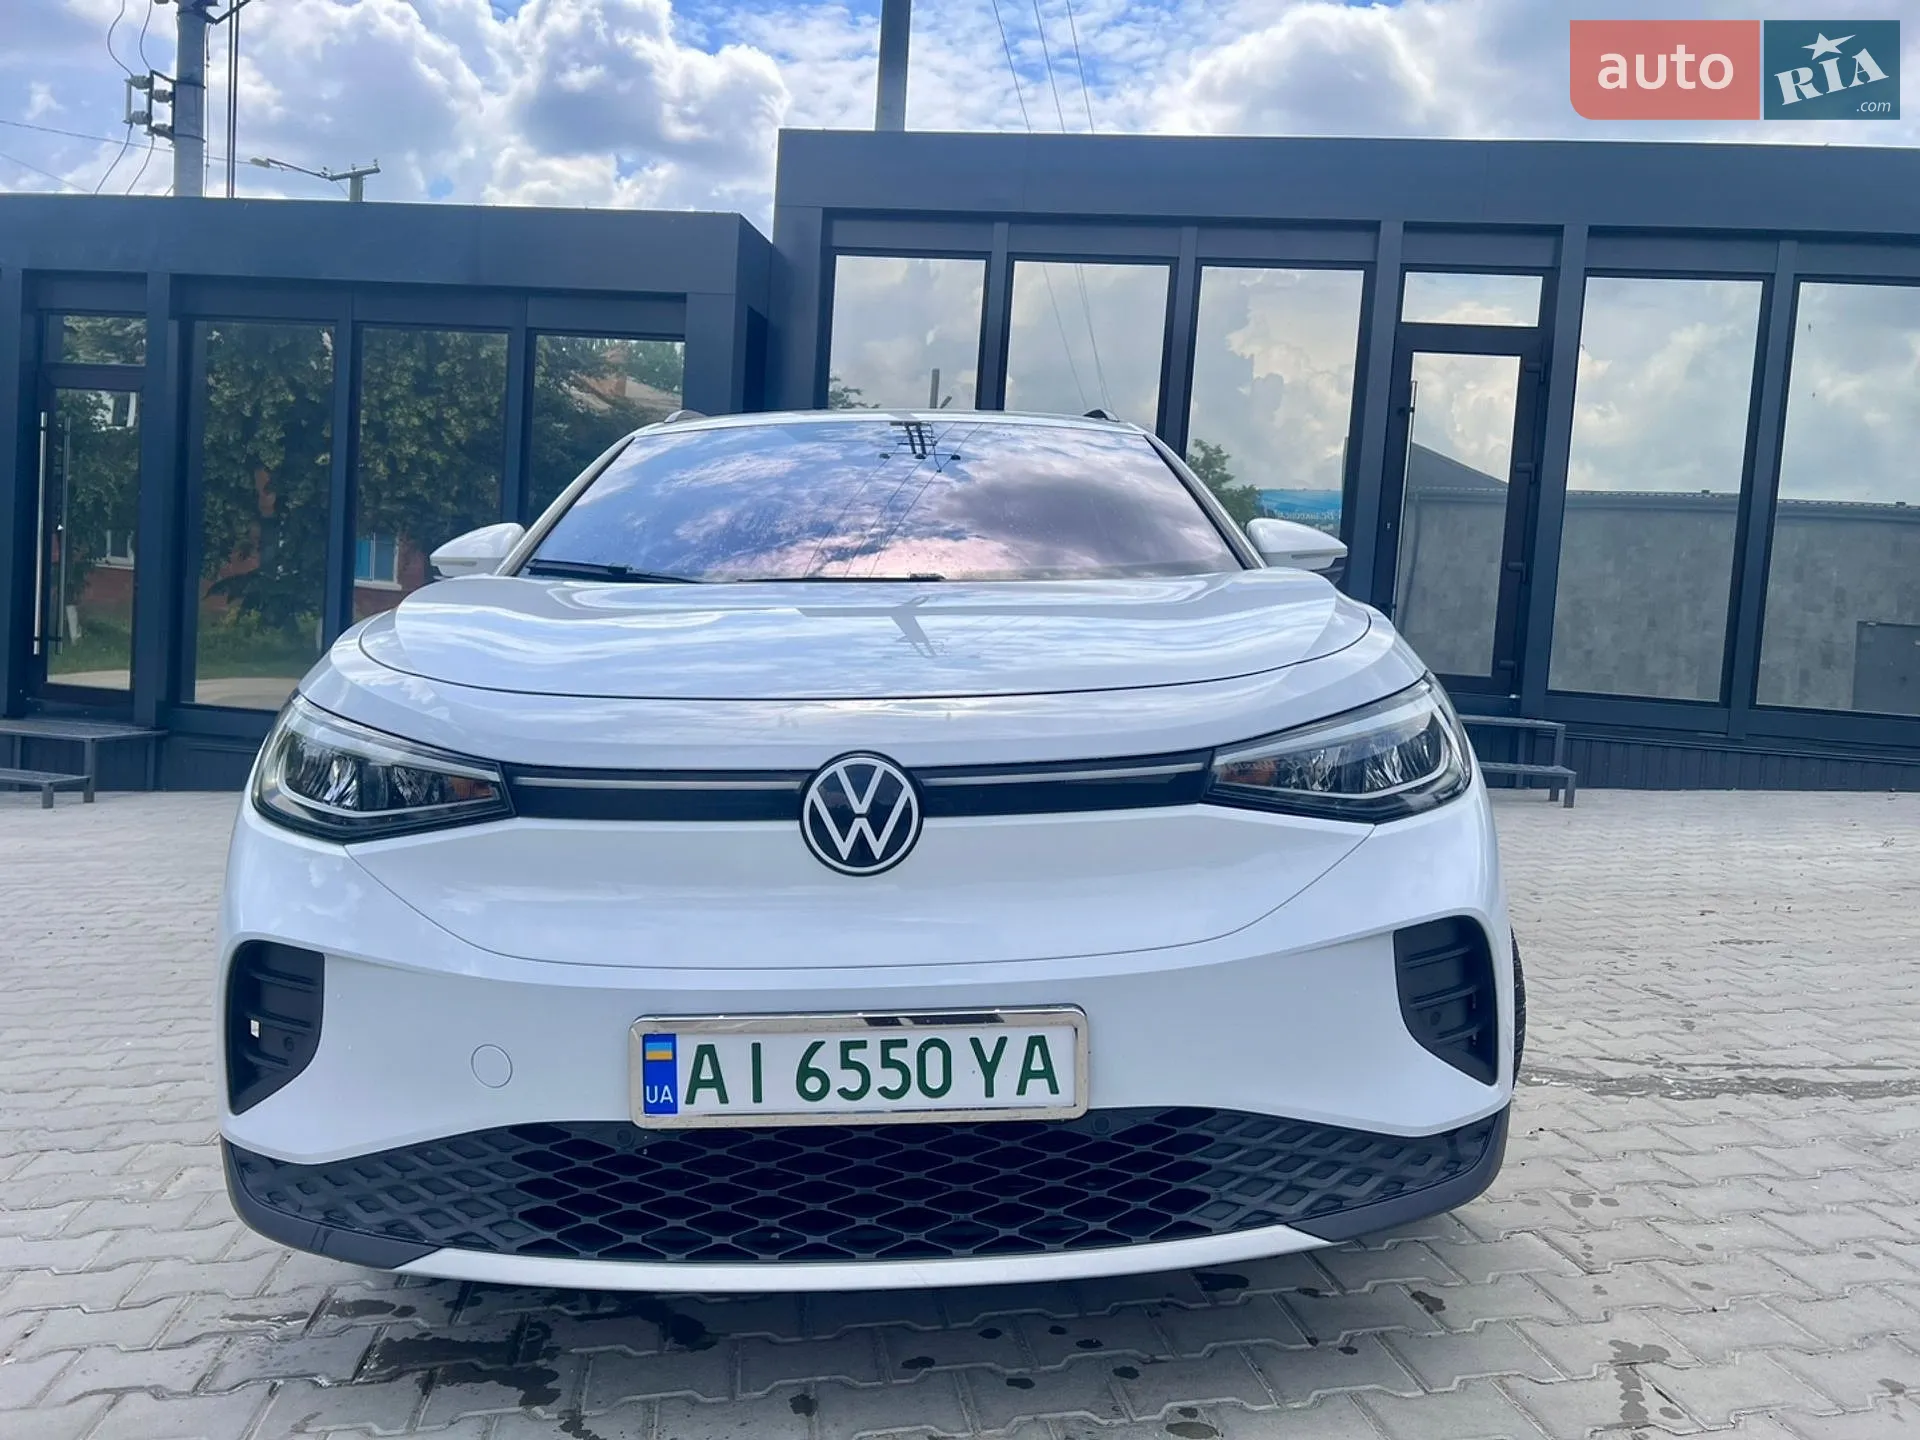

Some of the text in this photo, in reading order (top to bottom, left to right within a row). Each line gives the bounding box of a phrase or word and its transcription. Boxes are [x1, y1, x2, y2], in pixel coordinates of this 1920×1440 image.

[684, 1034, 1060, 1105] AI 6550 YA
[645, 1085, 674, 1105] UA
